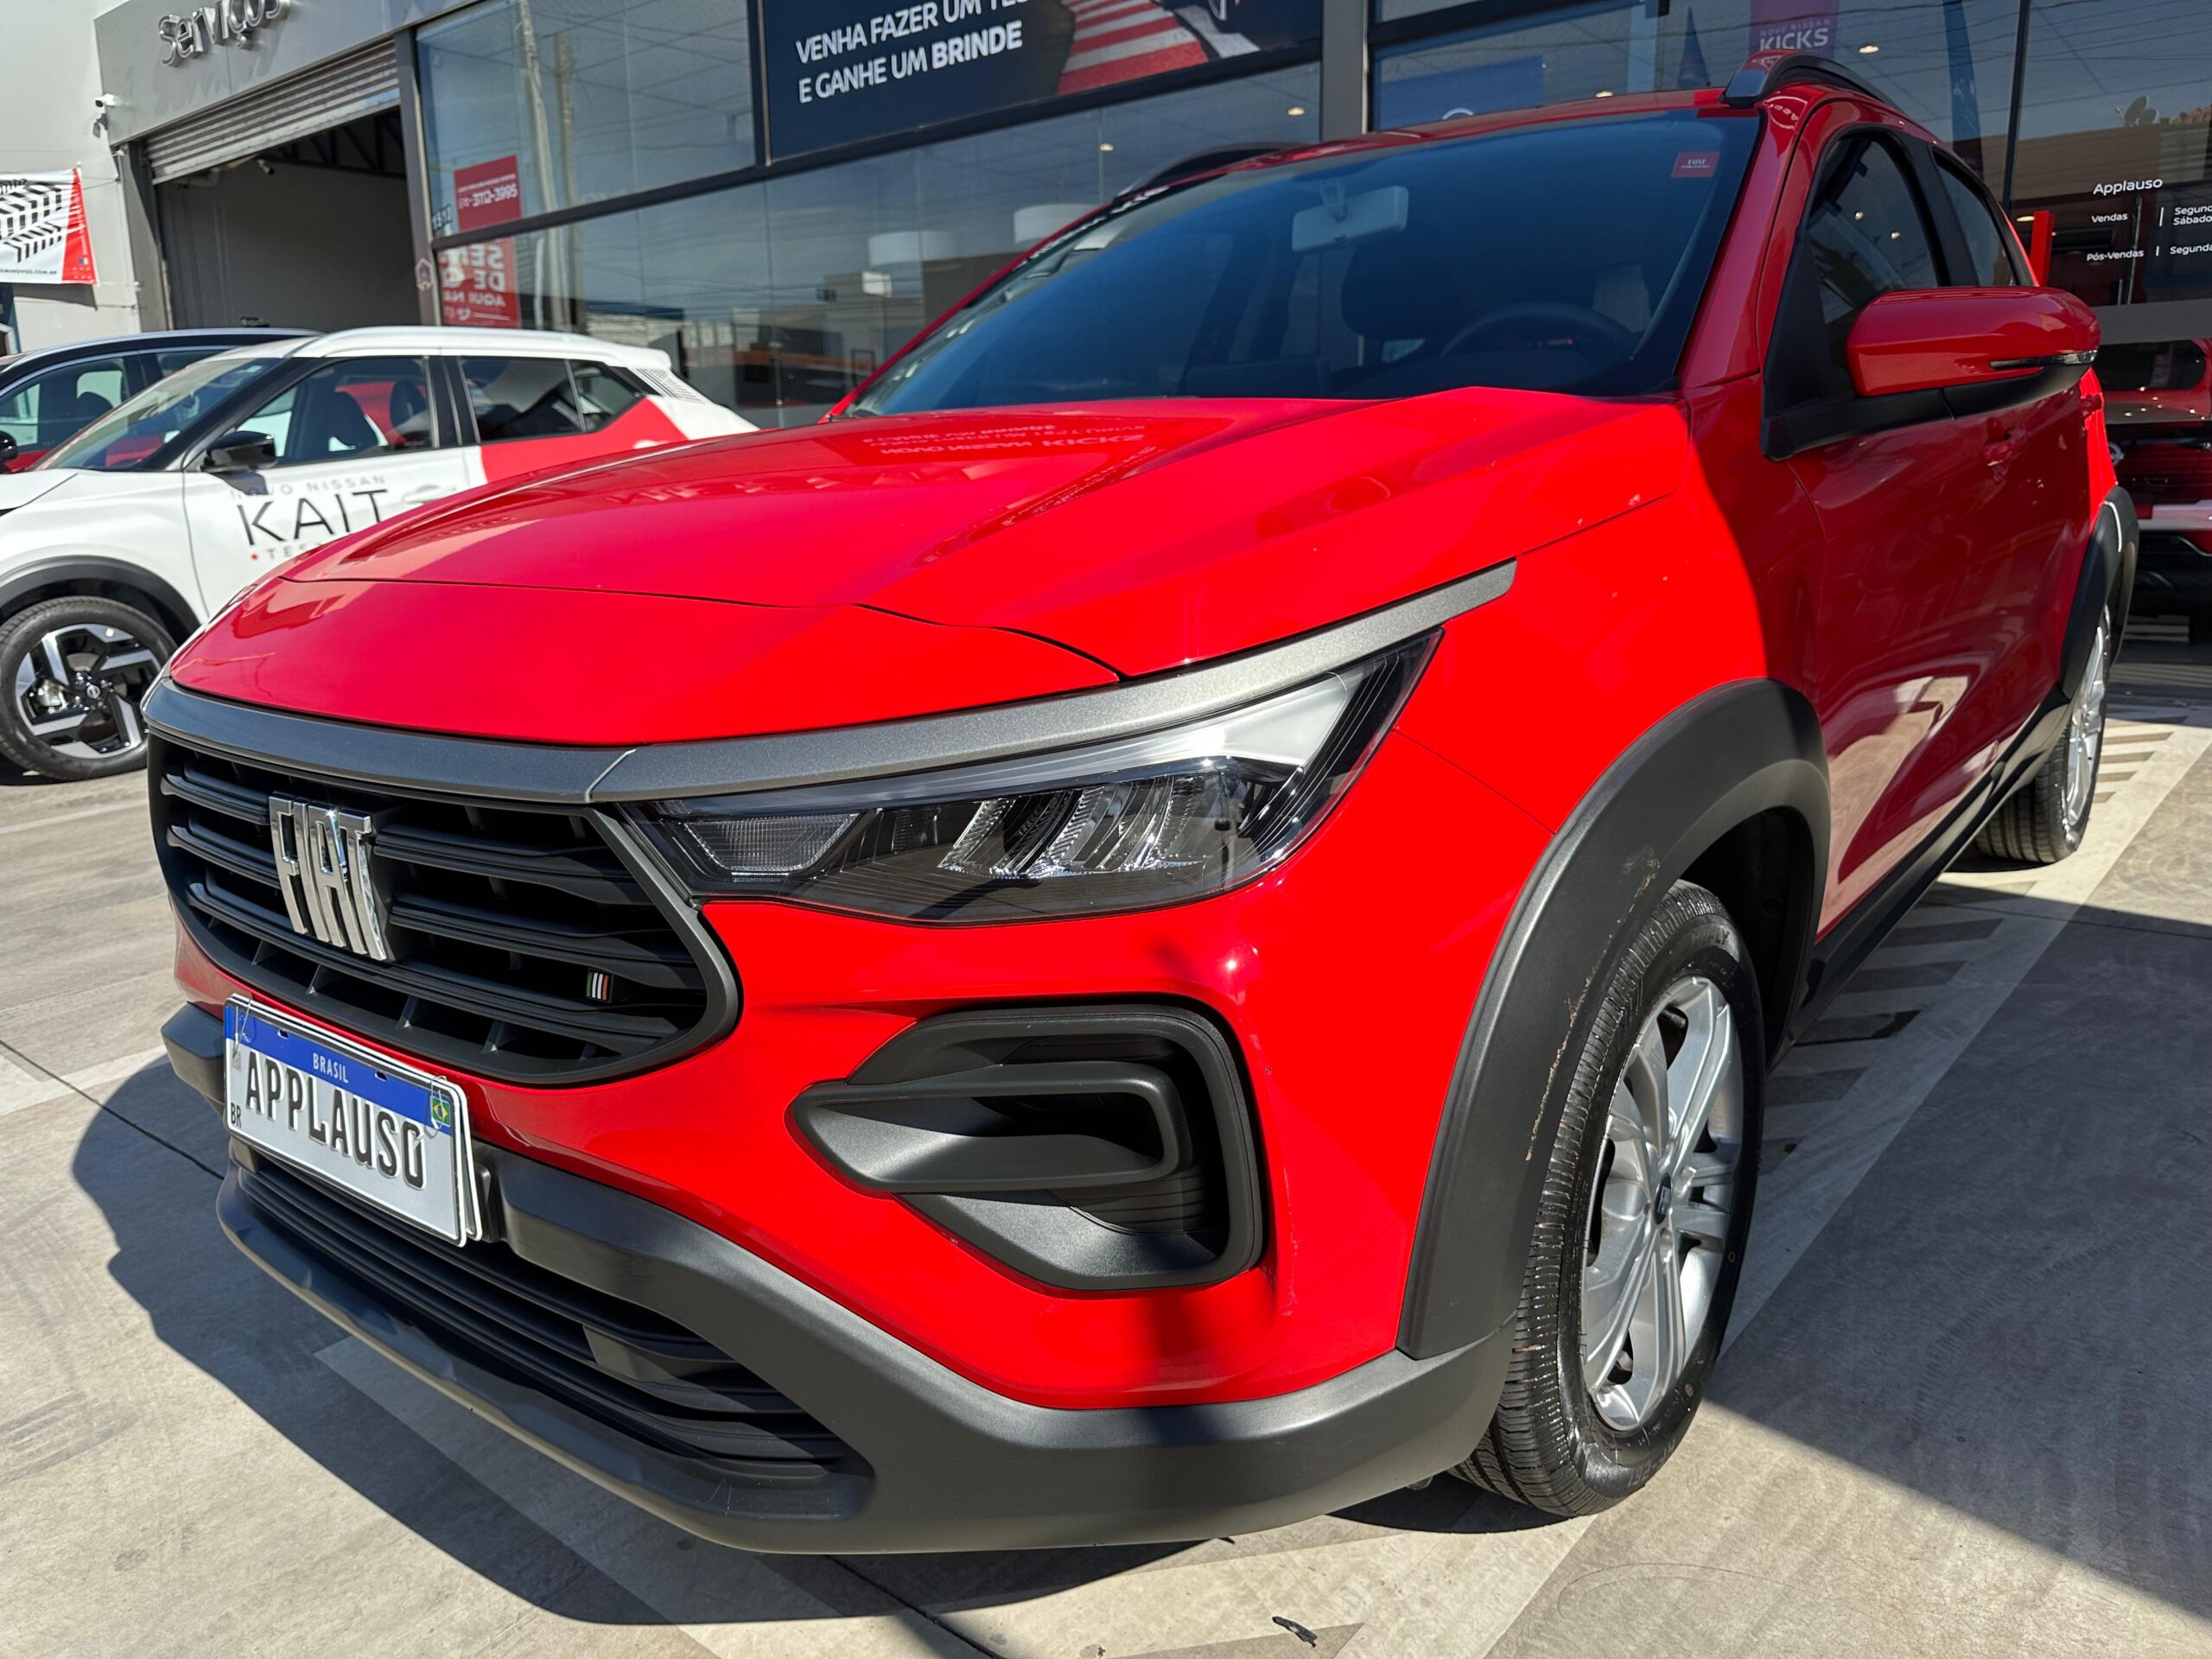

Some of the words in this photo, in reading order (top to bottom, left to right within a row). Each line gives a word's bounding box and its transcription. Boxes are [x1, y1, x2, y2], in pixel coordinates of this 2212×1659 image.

[795, 22, 868, 64] VENHA
[870, 2, 939, 43] FAZER
[1759, 28, 1828, 51] KICKS
[798, 78, 813, 103] E
[815, 57, 887, 99] GANHE
[891, 47, 928, 79] UM
[931, 20, 1023, 69] BRINDE
[2093, 179, 2163, 196] Applauso
[2091, 213, 2128, 223] Vendas
[2086, 250, 2145, 262] Pós-Vendas
[306, 474, 385, 493] NISSAN
[237, 489, 387, 545] KAIT
[269, 793, 387, 961] FIAT
[312, 1052, 348, 1084] BRASIL
[230, 1103, 242, 1129] BR
[245, 1050, 427, 1190] APPLAUSO
